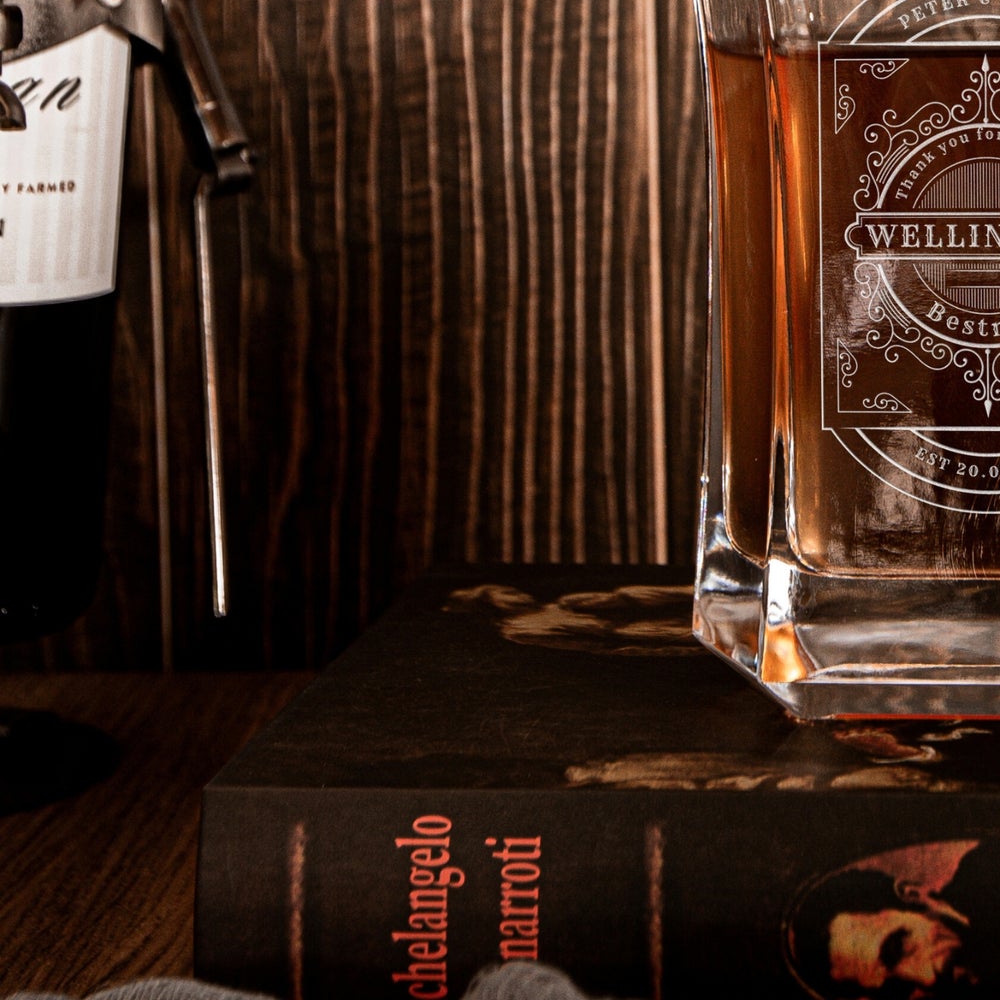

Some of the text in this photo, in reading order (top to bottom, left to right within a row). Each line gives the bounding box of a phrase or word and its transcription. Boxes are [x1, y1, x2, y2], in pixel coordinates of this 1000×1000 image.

[895, 151, 936, 201] Thank
[937, 132, 970, 156] you
[914, 446, 951, 471] EST
